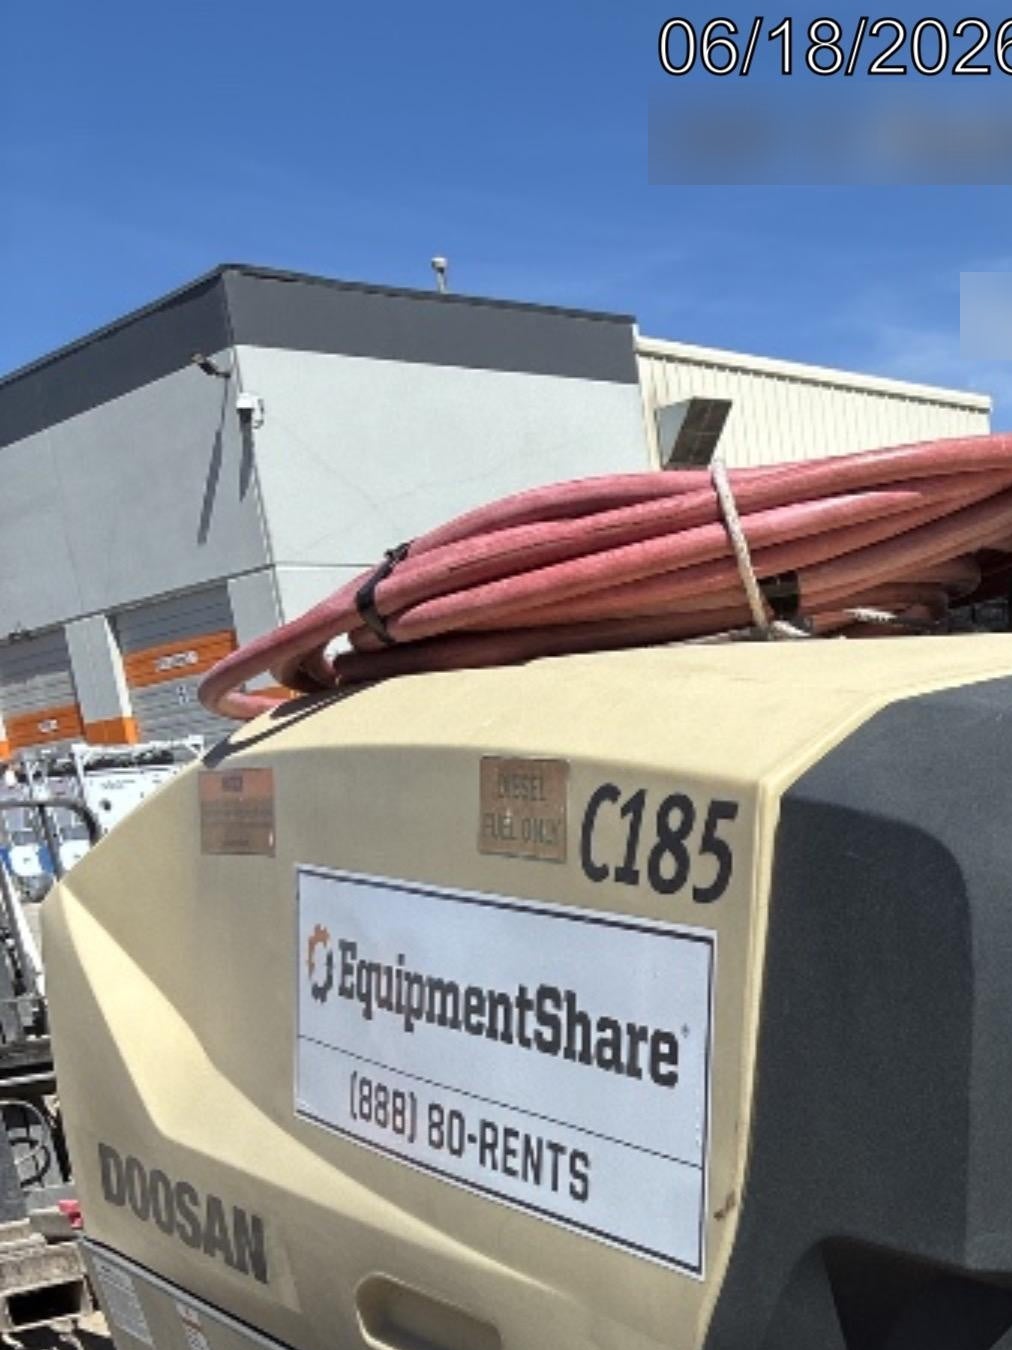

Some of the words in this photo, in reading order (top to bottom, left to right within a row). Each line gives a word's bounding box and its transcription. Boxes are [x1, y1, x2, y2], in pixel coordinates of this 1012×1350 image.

[581, 782, 738, 904] C185
[338, 938, 680, 1089] EquipmentShare
[350, 1070, 418, 1144] (888)
[427, 1102, 591, 1203] 80-RENTS
[98, 1142, 268, 1284] DOOSAN
